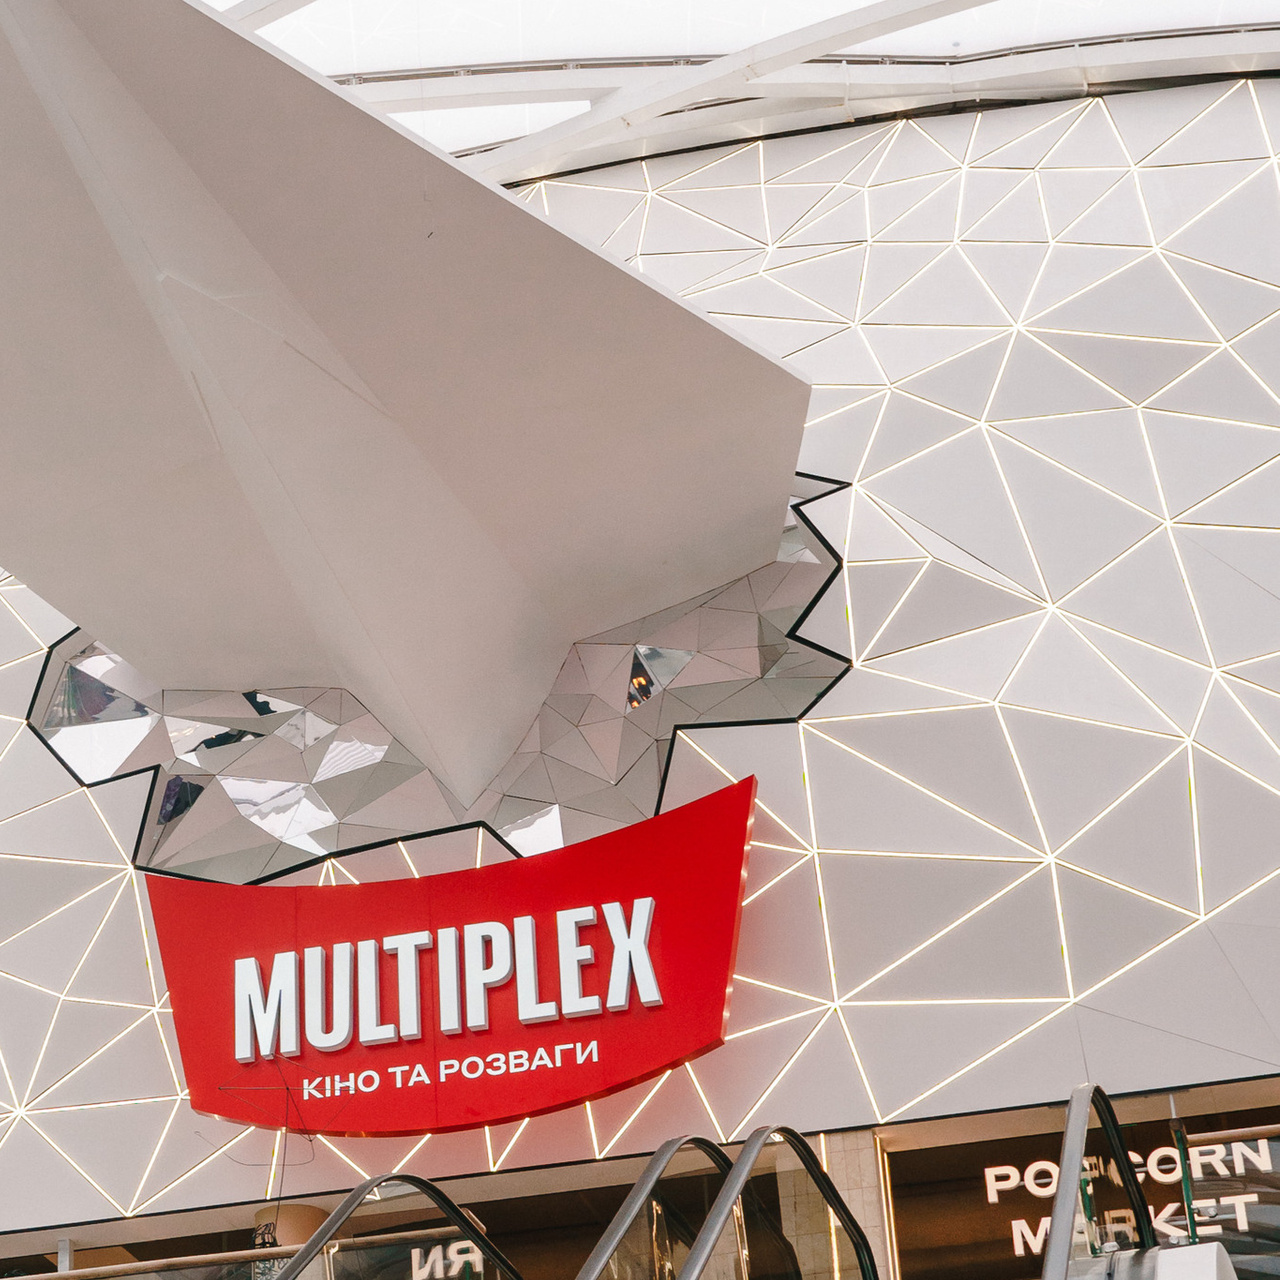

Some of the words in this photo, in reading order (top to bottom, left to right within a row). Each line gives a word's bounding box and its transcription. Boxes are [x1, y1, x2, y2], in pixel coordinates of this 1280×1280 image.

[234, 896, 663, 1063] MULTIPLEX
[303, 1070, 380, 1100] КІНО
[388, 1064, 430, 1088] ТА
[440, 1040, 600, 1083] РОЗВАГИ
